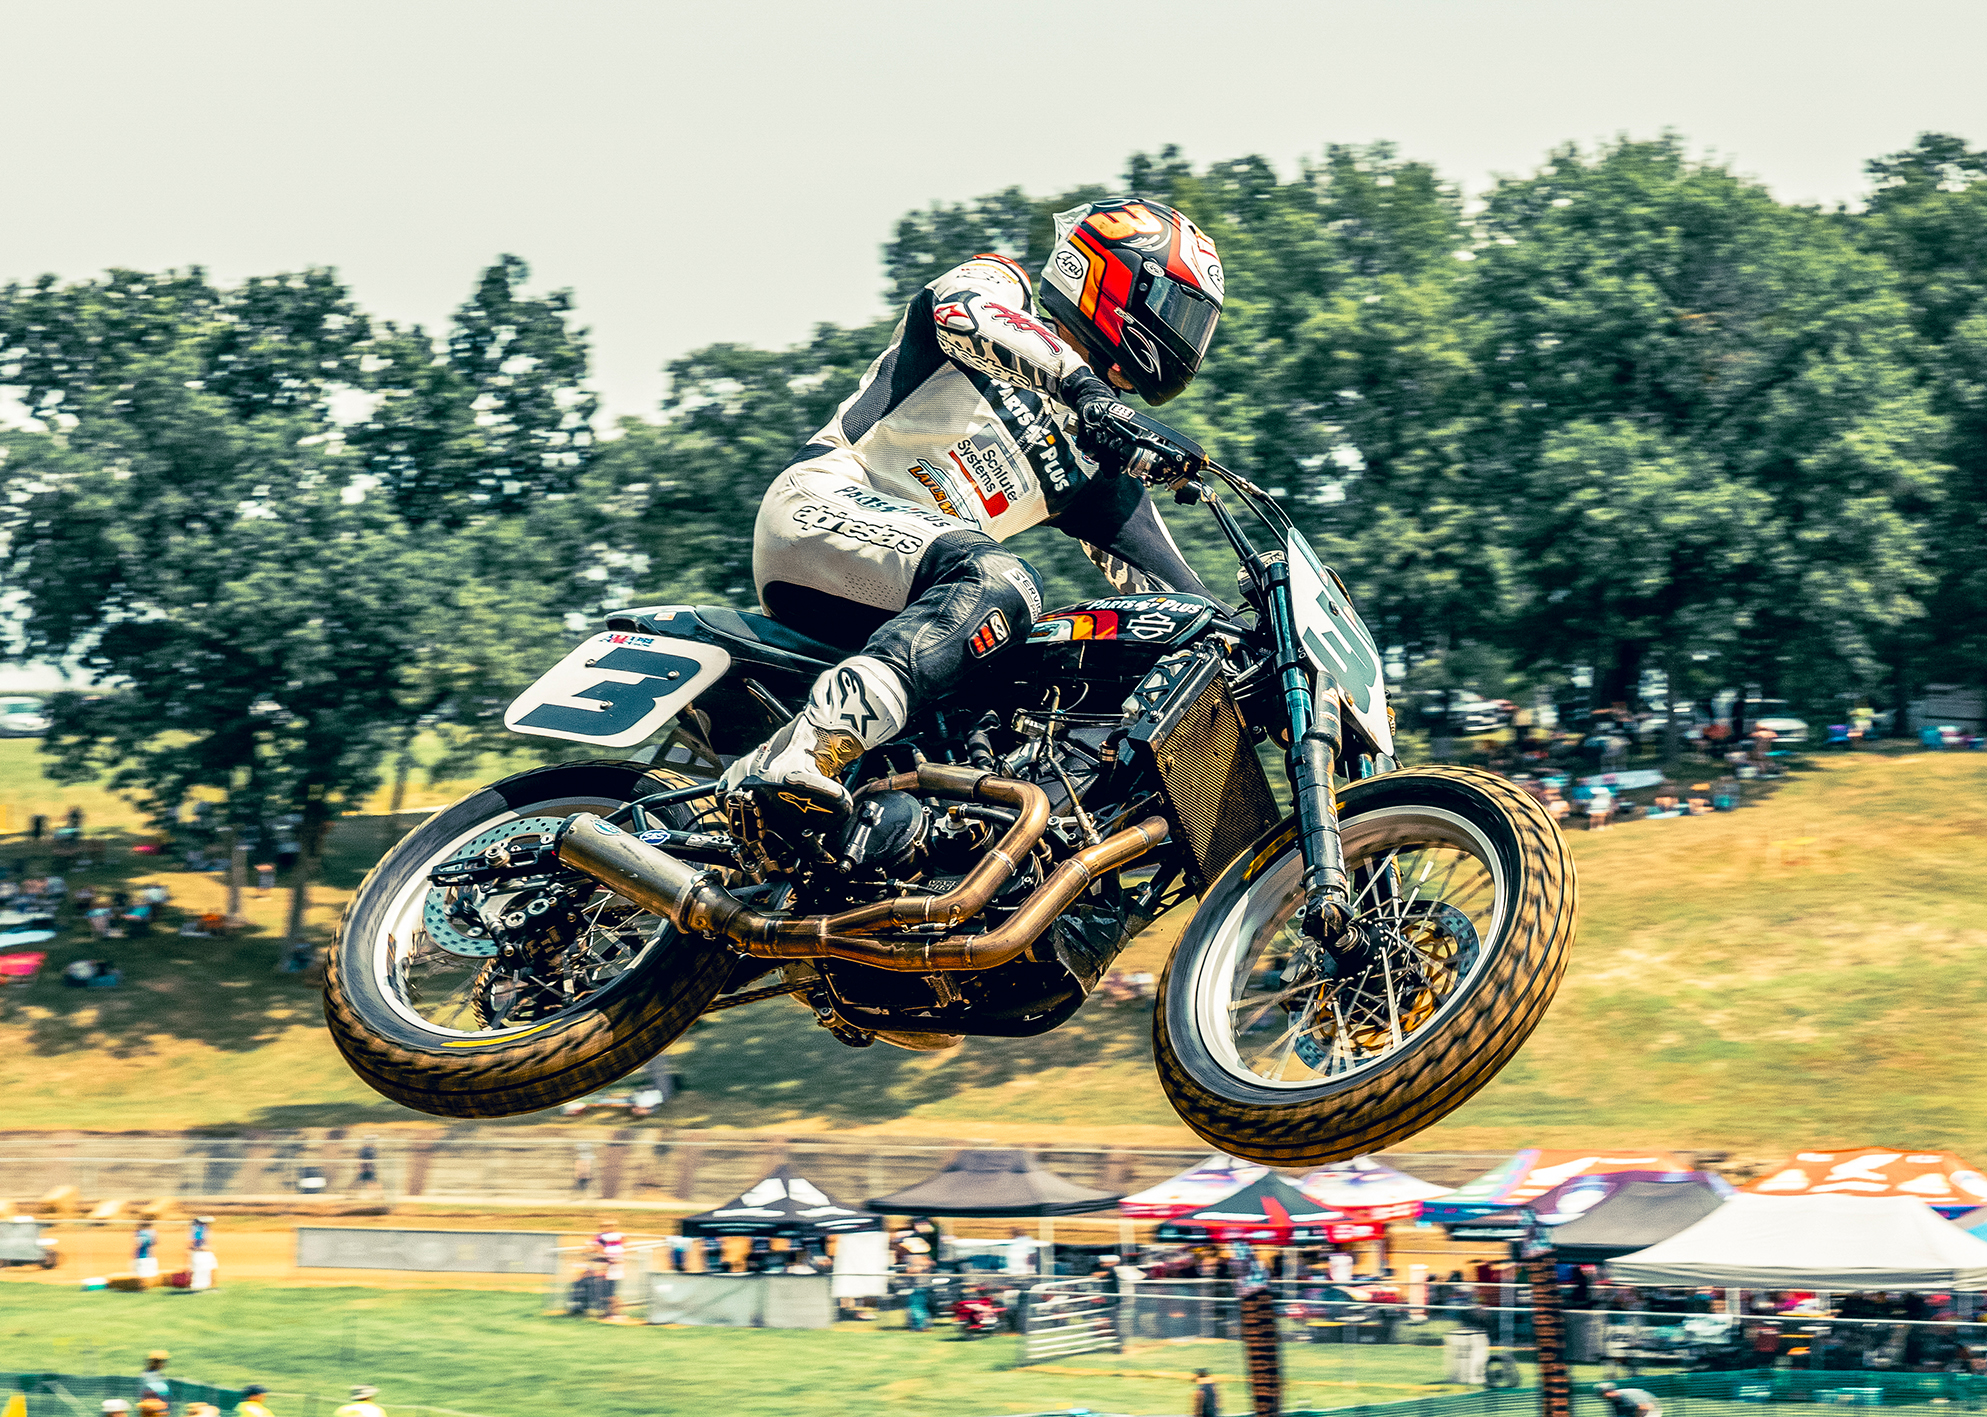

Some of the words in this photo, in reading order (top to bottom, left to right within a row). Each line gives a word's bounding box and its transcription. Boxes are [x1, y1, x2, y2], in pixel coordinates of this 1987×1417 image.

[1084, 204, 1164, 240] 3
[1056, 251, 1083, 278] Arai
[908, 466, 945, 502] LATUS
[958, 438, 996, 493] Systems
[983, 450, 1018, 502] Schluter
[1040, 449, 1069, 491] PLUS
[793, 506, 923, 554] alpinestars
[1086, 599, 1135, 611] PARTS
[1157, 599, 1202, 614] PLUS
[1302, 590, 1377, 714] 3
[513, 647, 701, 736] 3
